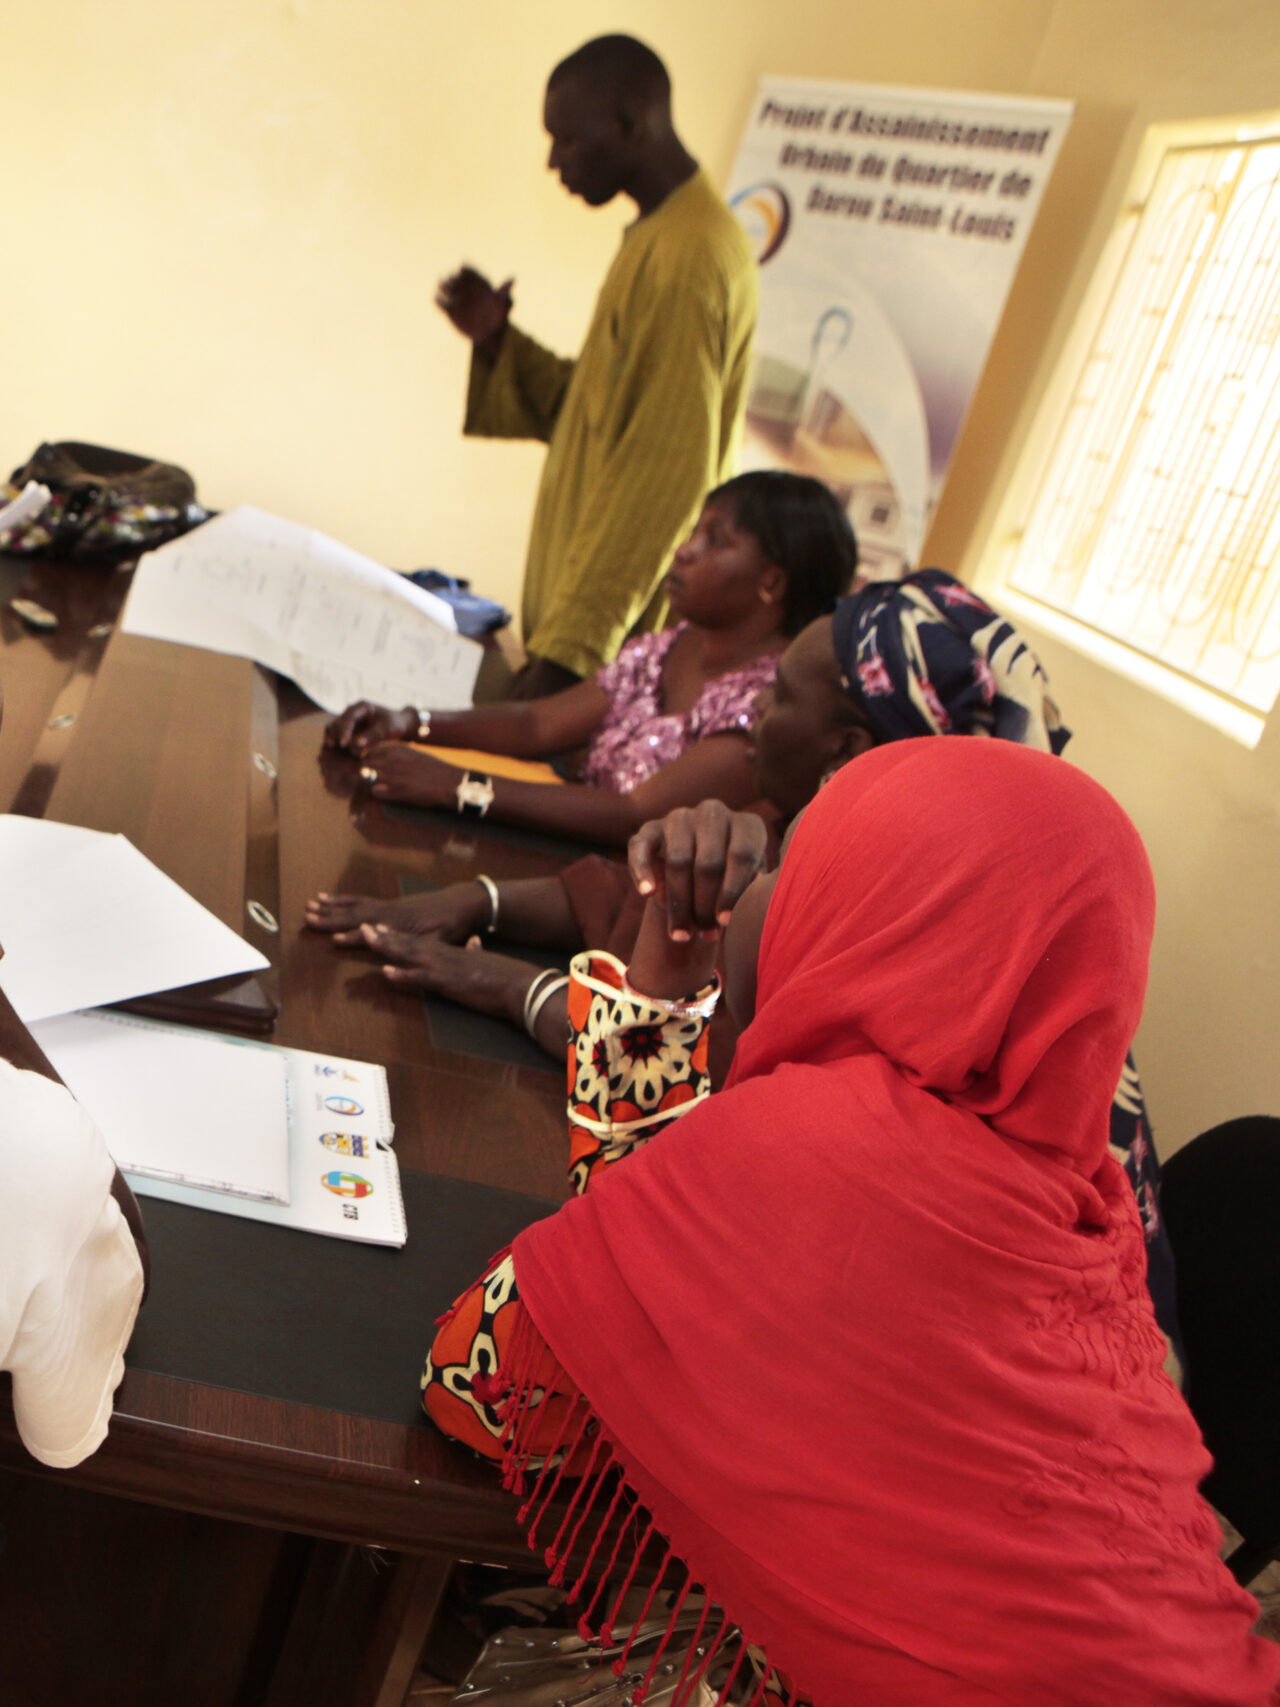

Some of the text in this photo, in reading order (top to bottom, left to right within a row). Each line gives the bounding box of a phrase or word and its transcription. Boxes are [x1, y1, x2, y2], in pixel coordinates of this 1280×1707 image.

[859, 155, 888, 178] du
[892, 157, 995, 191] Quartier
[999, 170, 1032, 197] de
